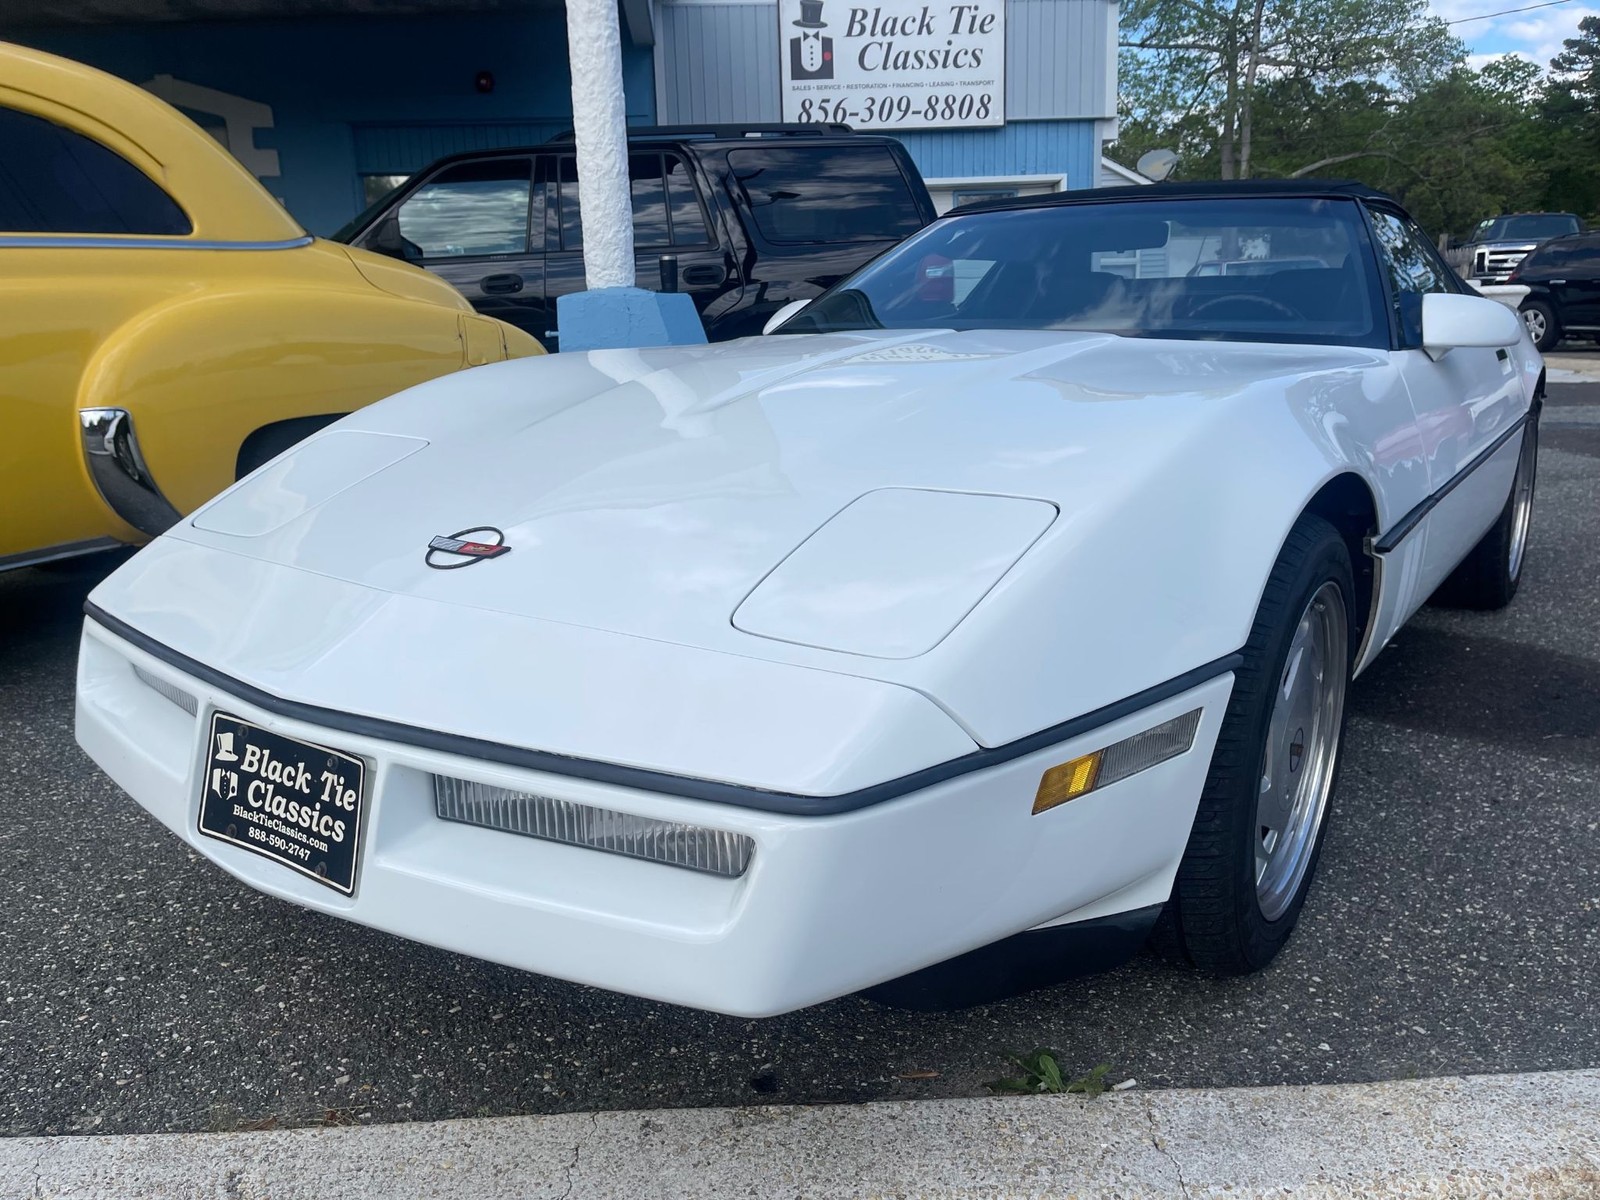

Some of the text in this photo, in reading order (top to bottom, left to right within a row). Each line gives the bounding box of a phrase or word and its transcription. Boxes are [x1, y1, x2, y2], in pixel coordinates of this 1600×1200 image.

[843, 4, 996, 38] Black Tie
[858, 39, 984, 72] Classics
[791, 79, 995, 92] SALES SERVICE RESTORATION FINANCING LEASING TRANSPORT
[797, 93, 992, 124] 856-309-8808
[240, 743, 357, 812] Black Tie
[232, 803, 329, 853] BlackTieClassics.com
[247, 779, 346, 843] Classics
[248, 826, 311, 862] 888-590-2747
